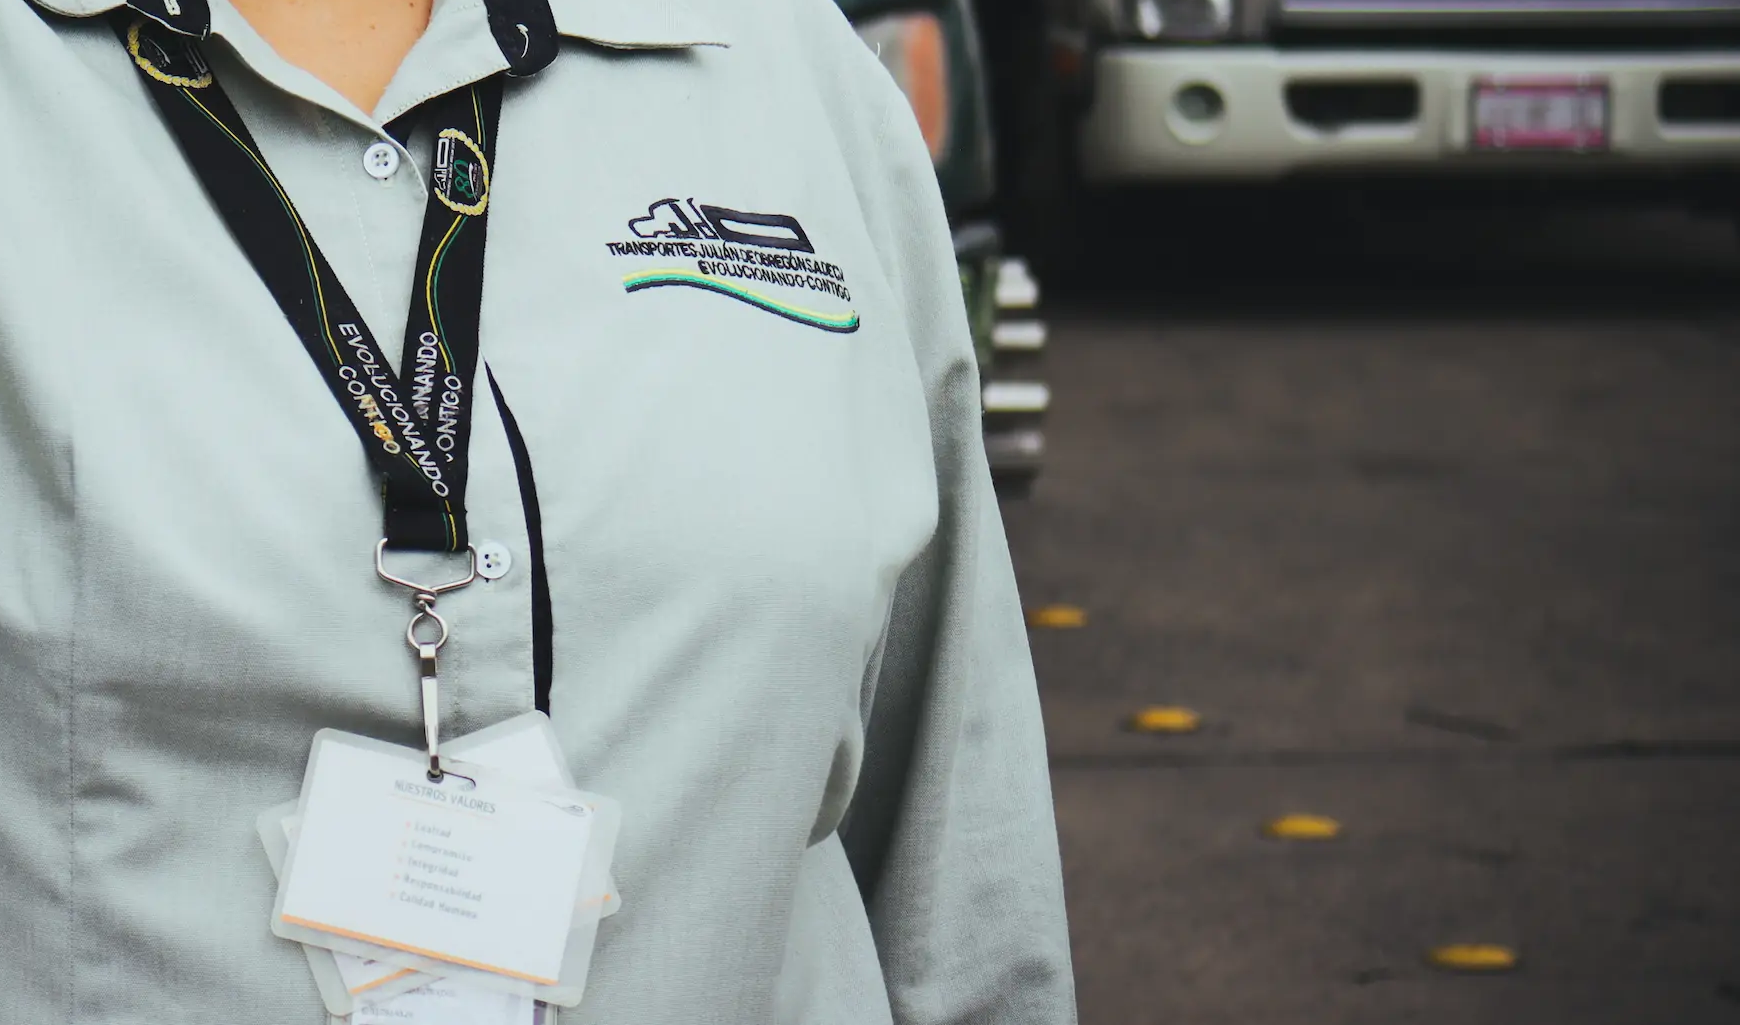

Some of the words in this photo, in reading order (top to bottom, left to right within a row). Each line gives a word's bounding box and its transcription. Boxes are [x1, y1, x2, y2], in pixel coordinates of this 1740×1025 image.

[606, 242, 697, 258] TRANSPORTES
[338, 323, 449, 497] EVOLUCIONANDO
[394, 779, 447, 802] NUESTROS
[450, 795, 496, 814] VALORES
